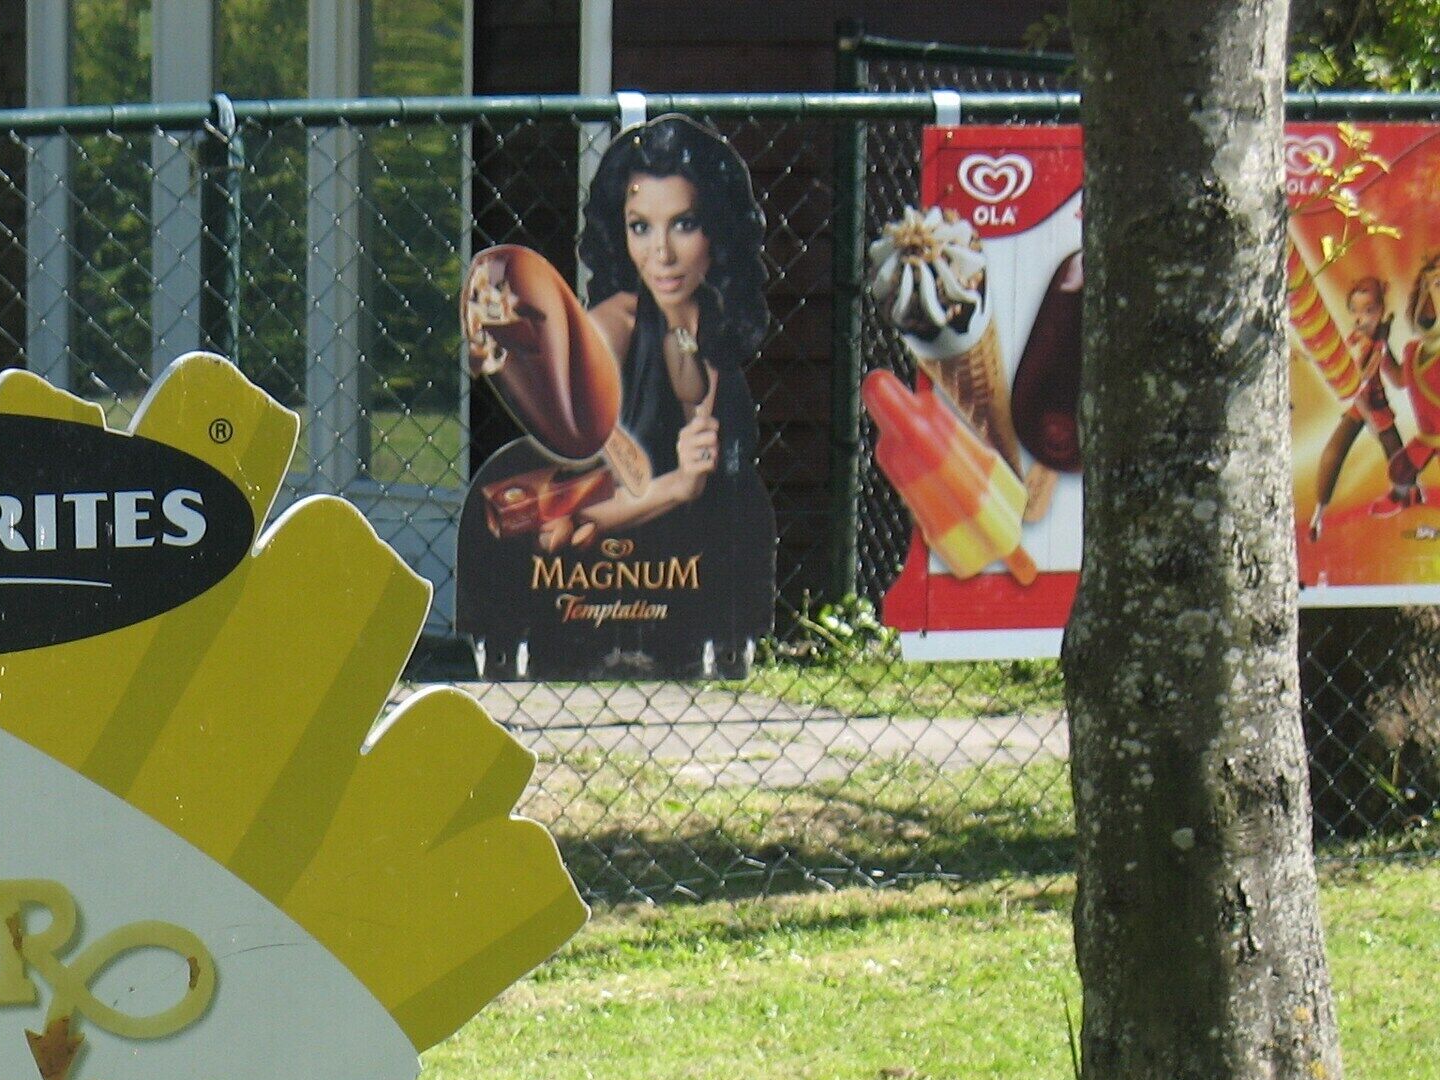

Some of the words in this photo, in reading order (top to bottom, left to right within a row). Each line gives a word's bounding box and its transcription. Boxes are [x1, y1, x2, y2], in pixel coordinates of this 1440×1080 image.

[1283, 180, 1321, 195] OLA
[972, 205, 1016, 227] OLA
[531, 552, 704, 590] MAGNUM
[555, 593, 670, 629] Temptation
